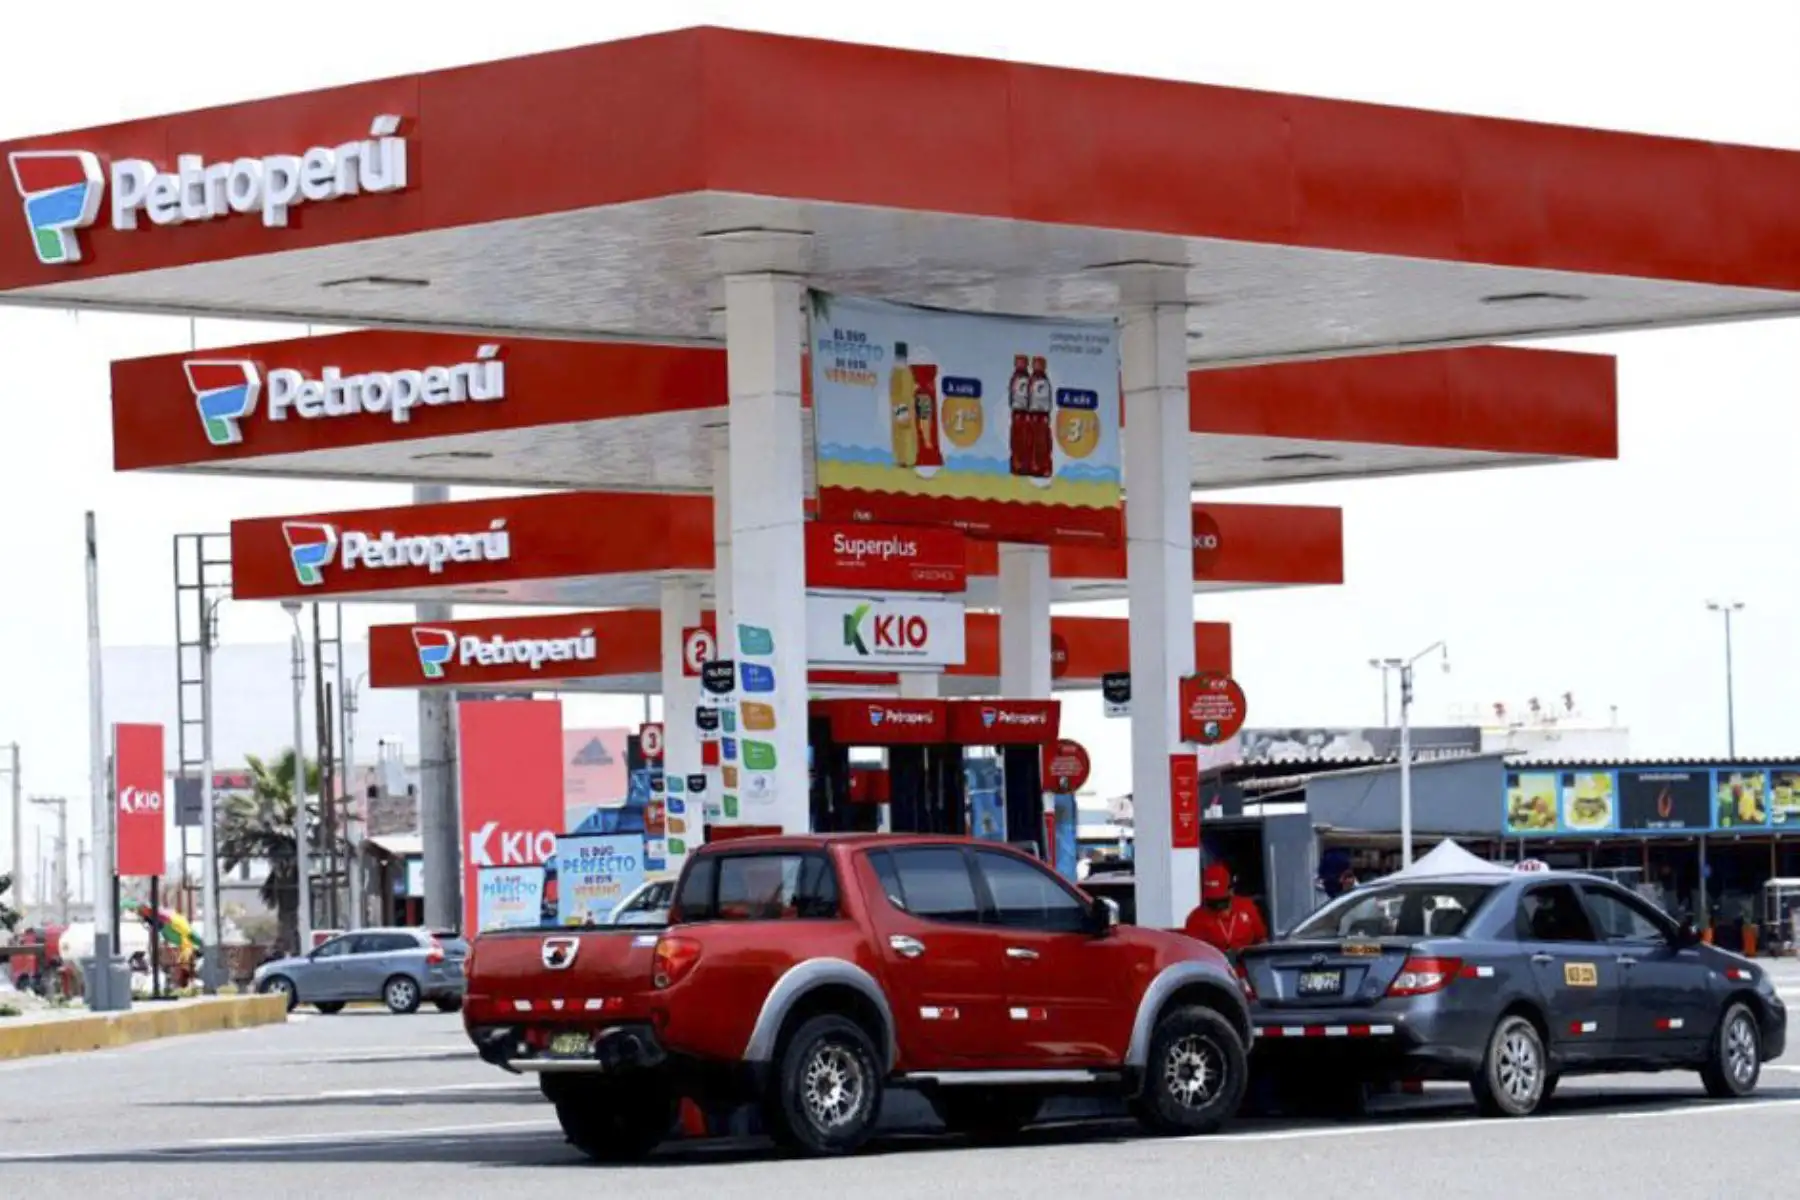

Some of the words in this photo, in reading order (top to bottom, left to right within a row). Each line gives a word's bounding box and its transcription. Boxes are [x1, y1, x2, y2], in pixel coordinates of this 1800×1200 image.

[111, 115, 407, 230] Petroperú
[267, 344, 505, 423] Petroperú
[341, 519, 511, 573] Petroperú
[833, 532, 918, 561] Superplus
[459, 629, 597, 669] Petroperú
[874, 613, 929, 650] KIO
[694, 640, 707, 663] 2
[647, 731, 657, 749] 3
[135, 791, 161, 810] KIO
[501, 829, 558, 865] KIO
[563, 855, 636, 873] PERFECTO
